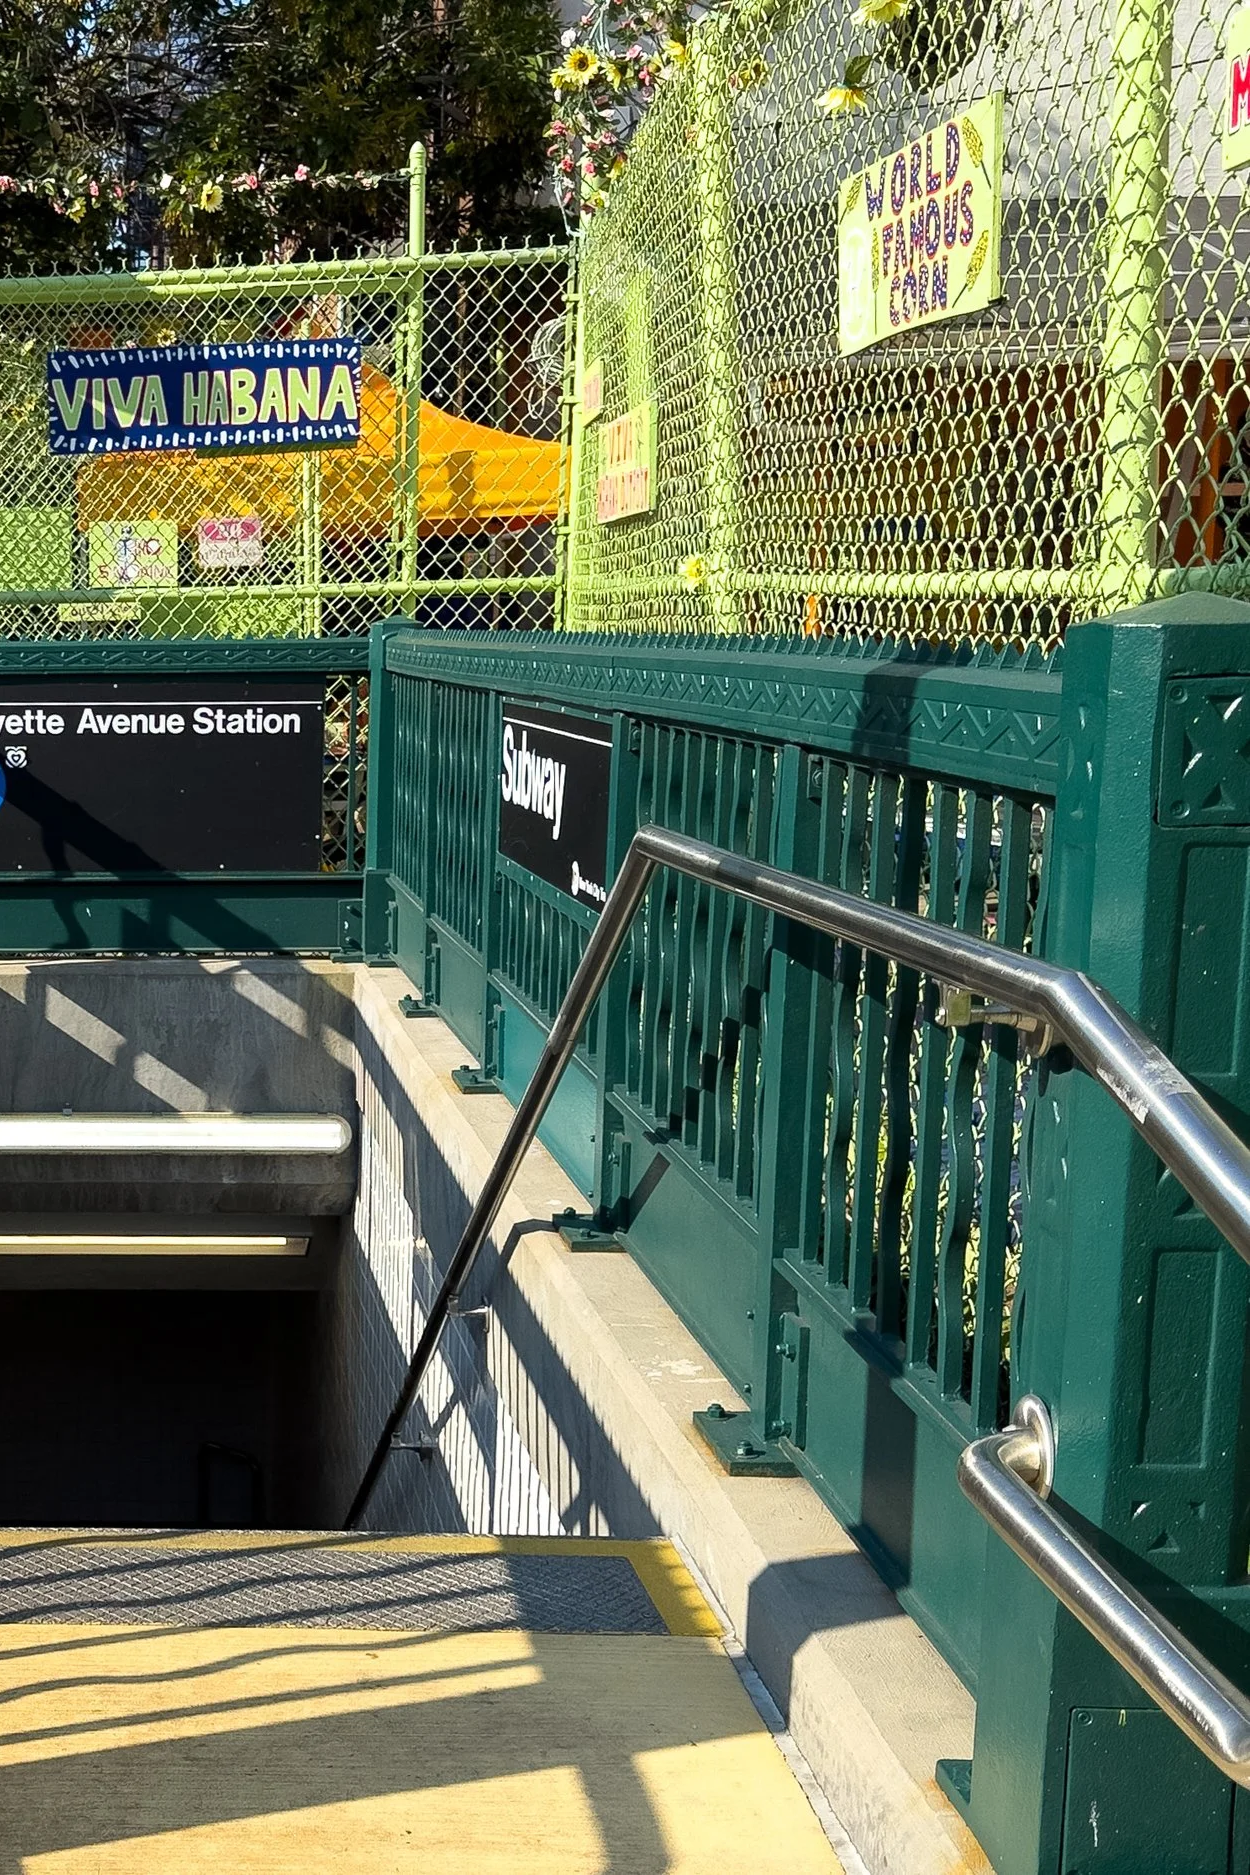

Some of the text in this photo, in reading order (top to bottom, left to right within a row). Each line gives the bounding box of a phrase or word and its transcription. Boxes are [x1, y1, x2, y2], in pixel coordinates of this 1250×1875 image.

[864, 122, 961, 222] WORLD
[882, 180, 974, 279] FAMOUS
[889, 255, 949, 327] CORN
[52, 365, 357, 431] VIVA HABANA
[76, 708, 186, 735] Avenue
[192, 707, 302, 735] Station
[501, 724, 567, 840] Subway
